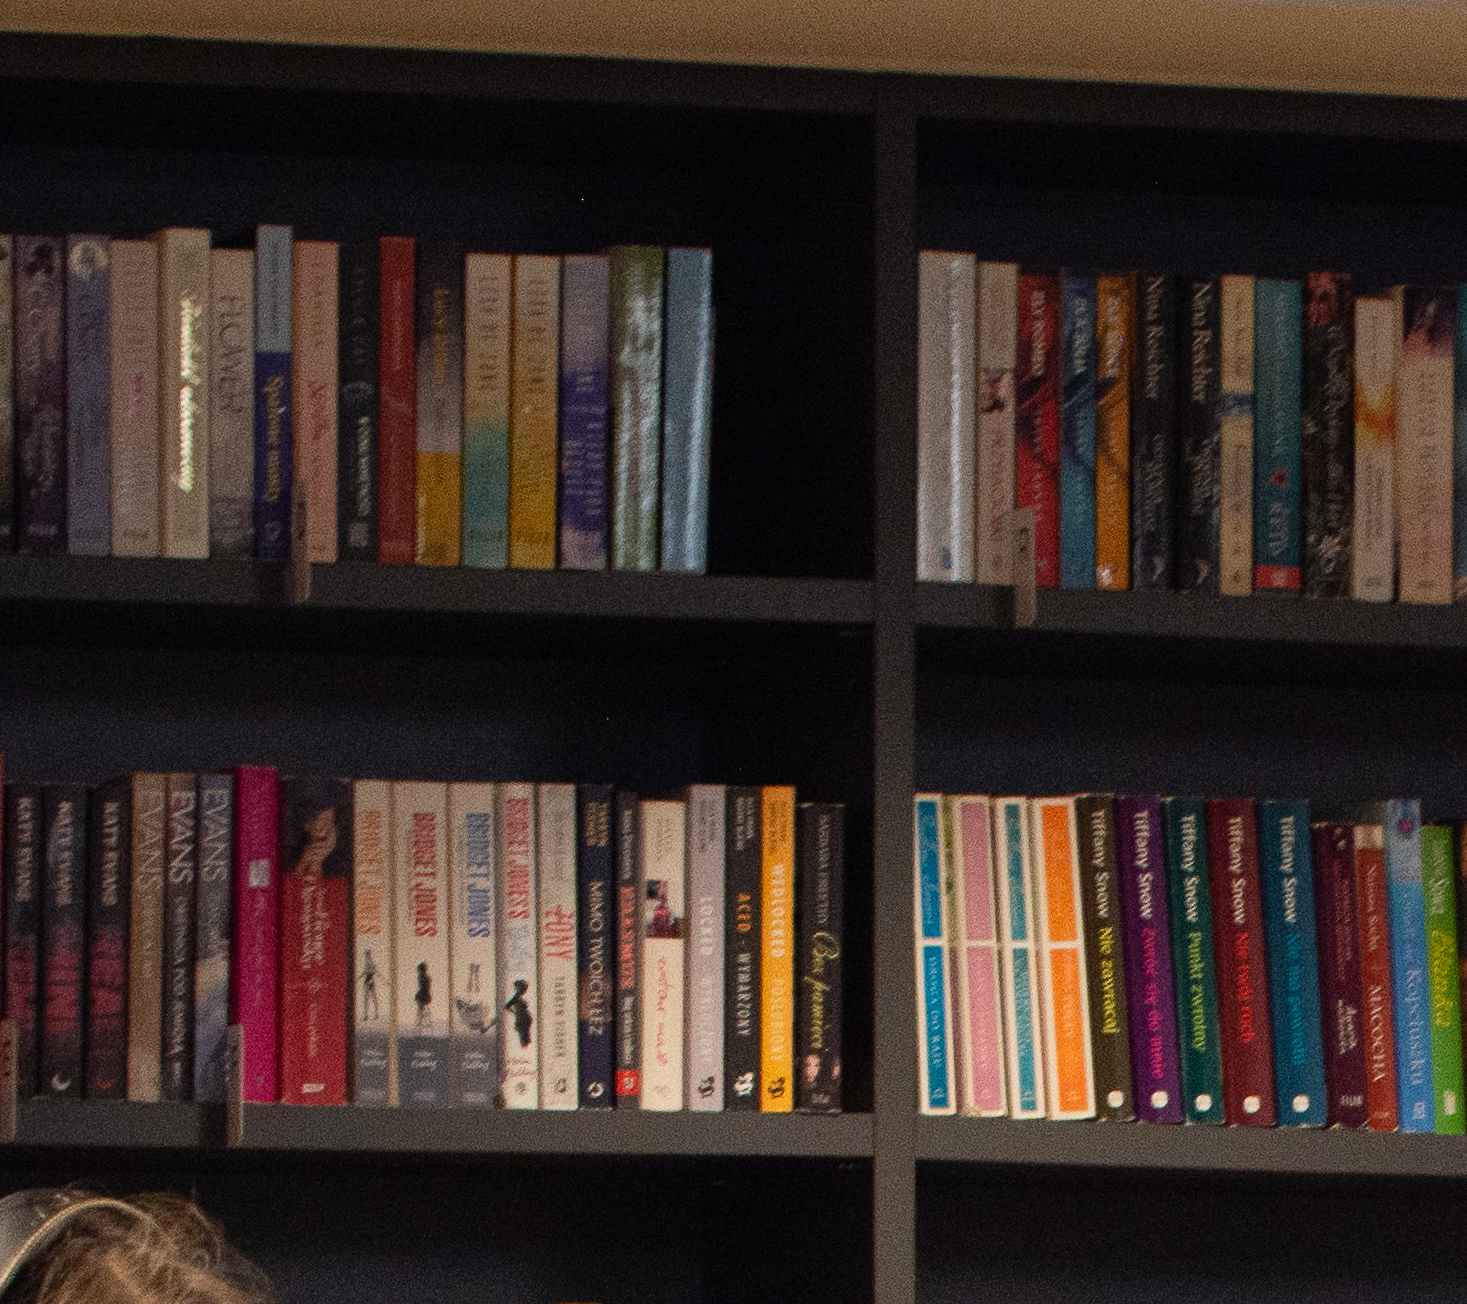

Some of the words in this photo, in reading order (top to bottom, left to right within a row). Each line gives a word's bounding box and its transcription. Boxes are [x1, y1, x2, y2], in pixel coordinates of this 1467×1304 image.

[138, 789, 162, 890] EVANS
[169, 790, 194, 884] EVANS
[202, 789, 228, 882] EVANS
[357, 810, 380, 879] BRIDGET
[413, 813, 437, 879] BRIDGET
[466, 813, 490, 879] BRIDGET
[1090, 809, 1107, 868] Tiffany
[1180, 814, 1196, 872] Tiffany
[1227, 816, 1243, 873] Tiffany
[357, 882, 380, 935] JONES
[411, 883, 437, 937] JONES
[467, 883, 491, 937] JONES
[1096, 872, 1111, 918] Snow
[1185, 876, 1200, 922] Snow
[1231, 878, 1246, 924] Snow
[1098, 927, 1115, 955] Nie
[1187, 931, 1203, 978] Punkt
[1236, 932, 1249, 960] Nie
[1100, 960, 1120, 1034] zawracaj
[1188, 984, 1207, 1052] zwrotny
[1240, 1006, 1255, 1042] ruch
